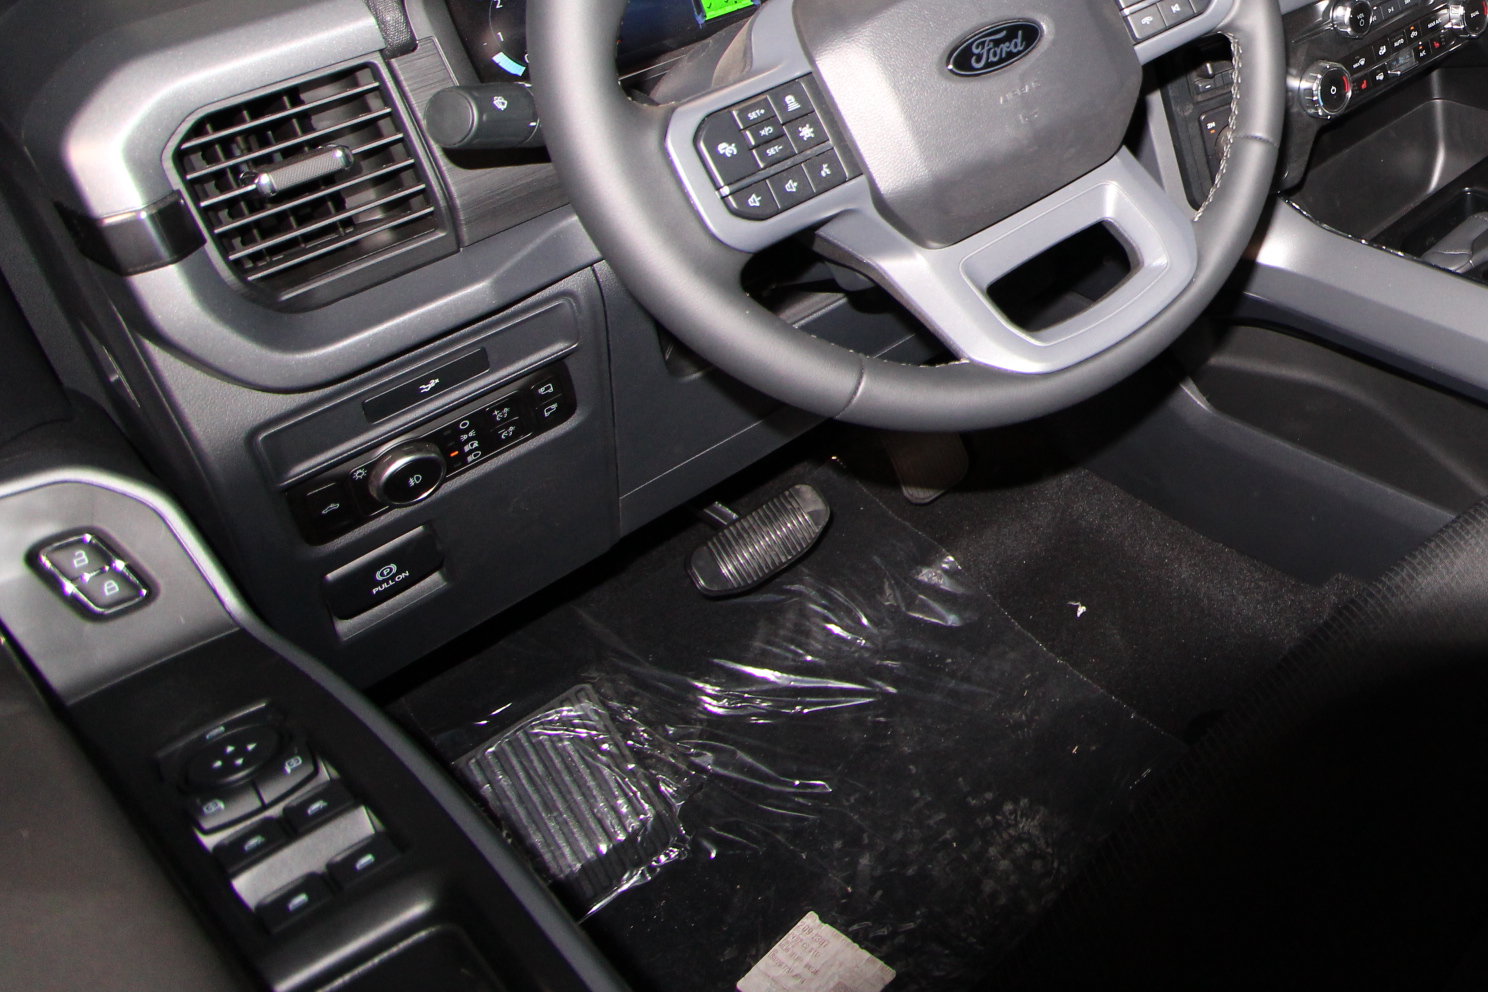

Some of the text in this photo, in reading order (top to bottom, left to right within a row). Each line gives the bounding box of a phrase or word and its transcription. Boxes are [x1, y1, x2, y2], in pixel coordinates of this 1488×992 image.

[497, 31, 504, 42] 1
[971, 30, 1026, 68] Ford
[747, 108, 765, 120] SET+
[372, 570, 410, 595] PULL ON
